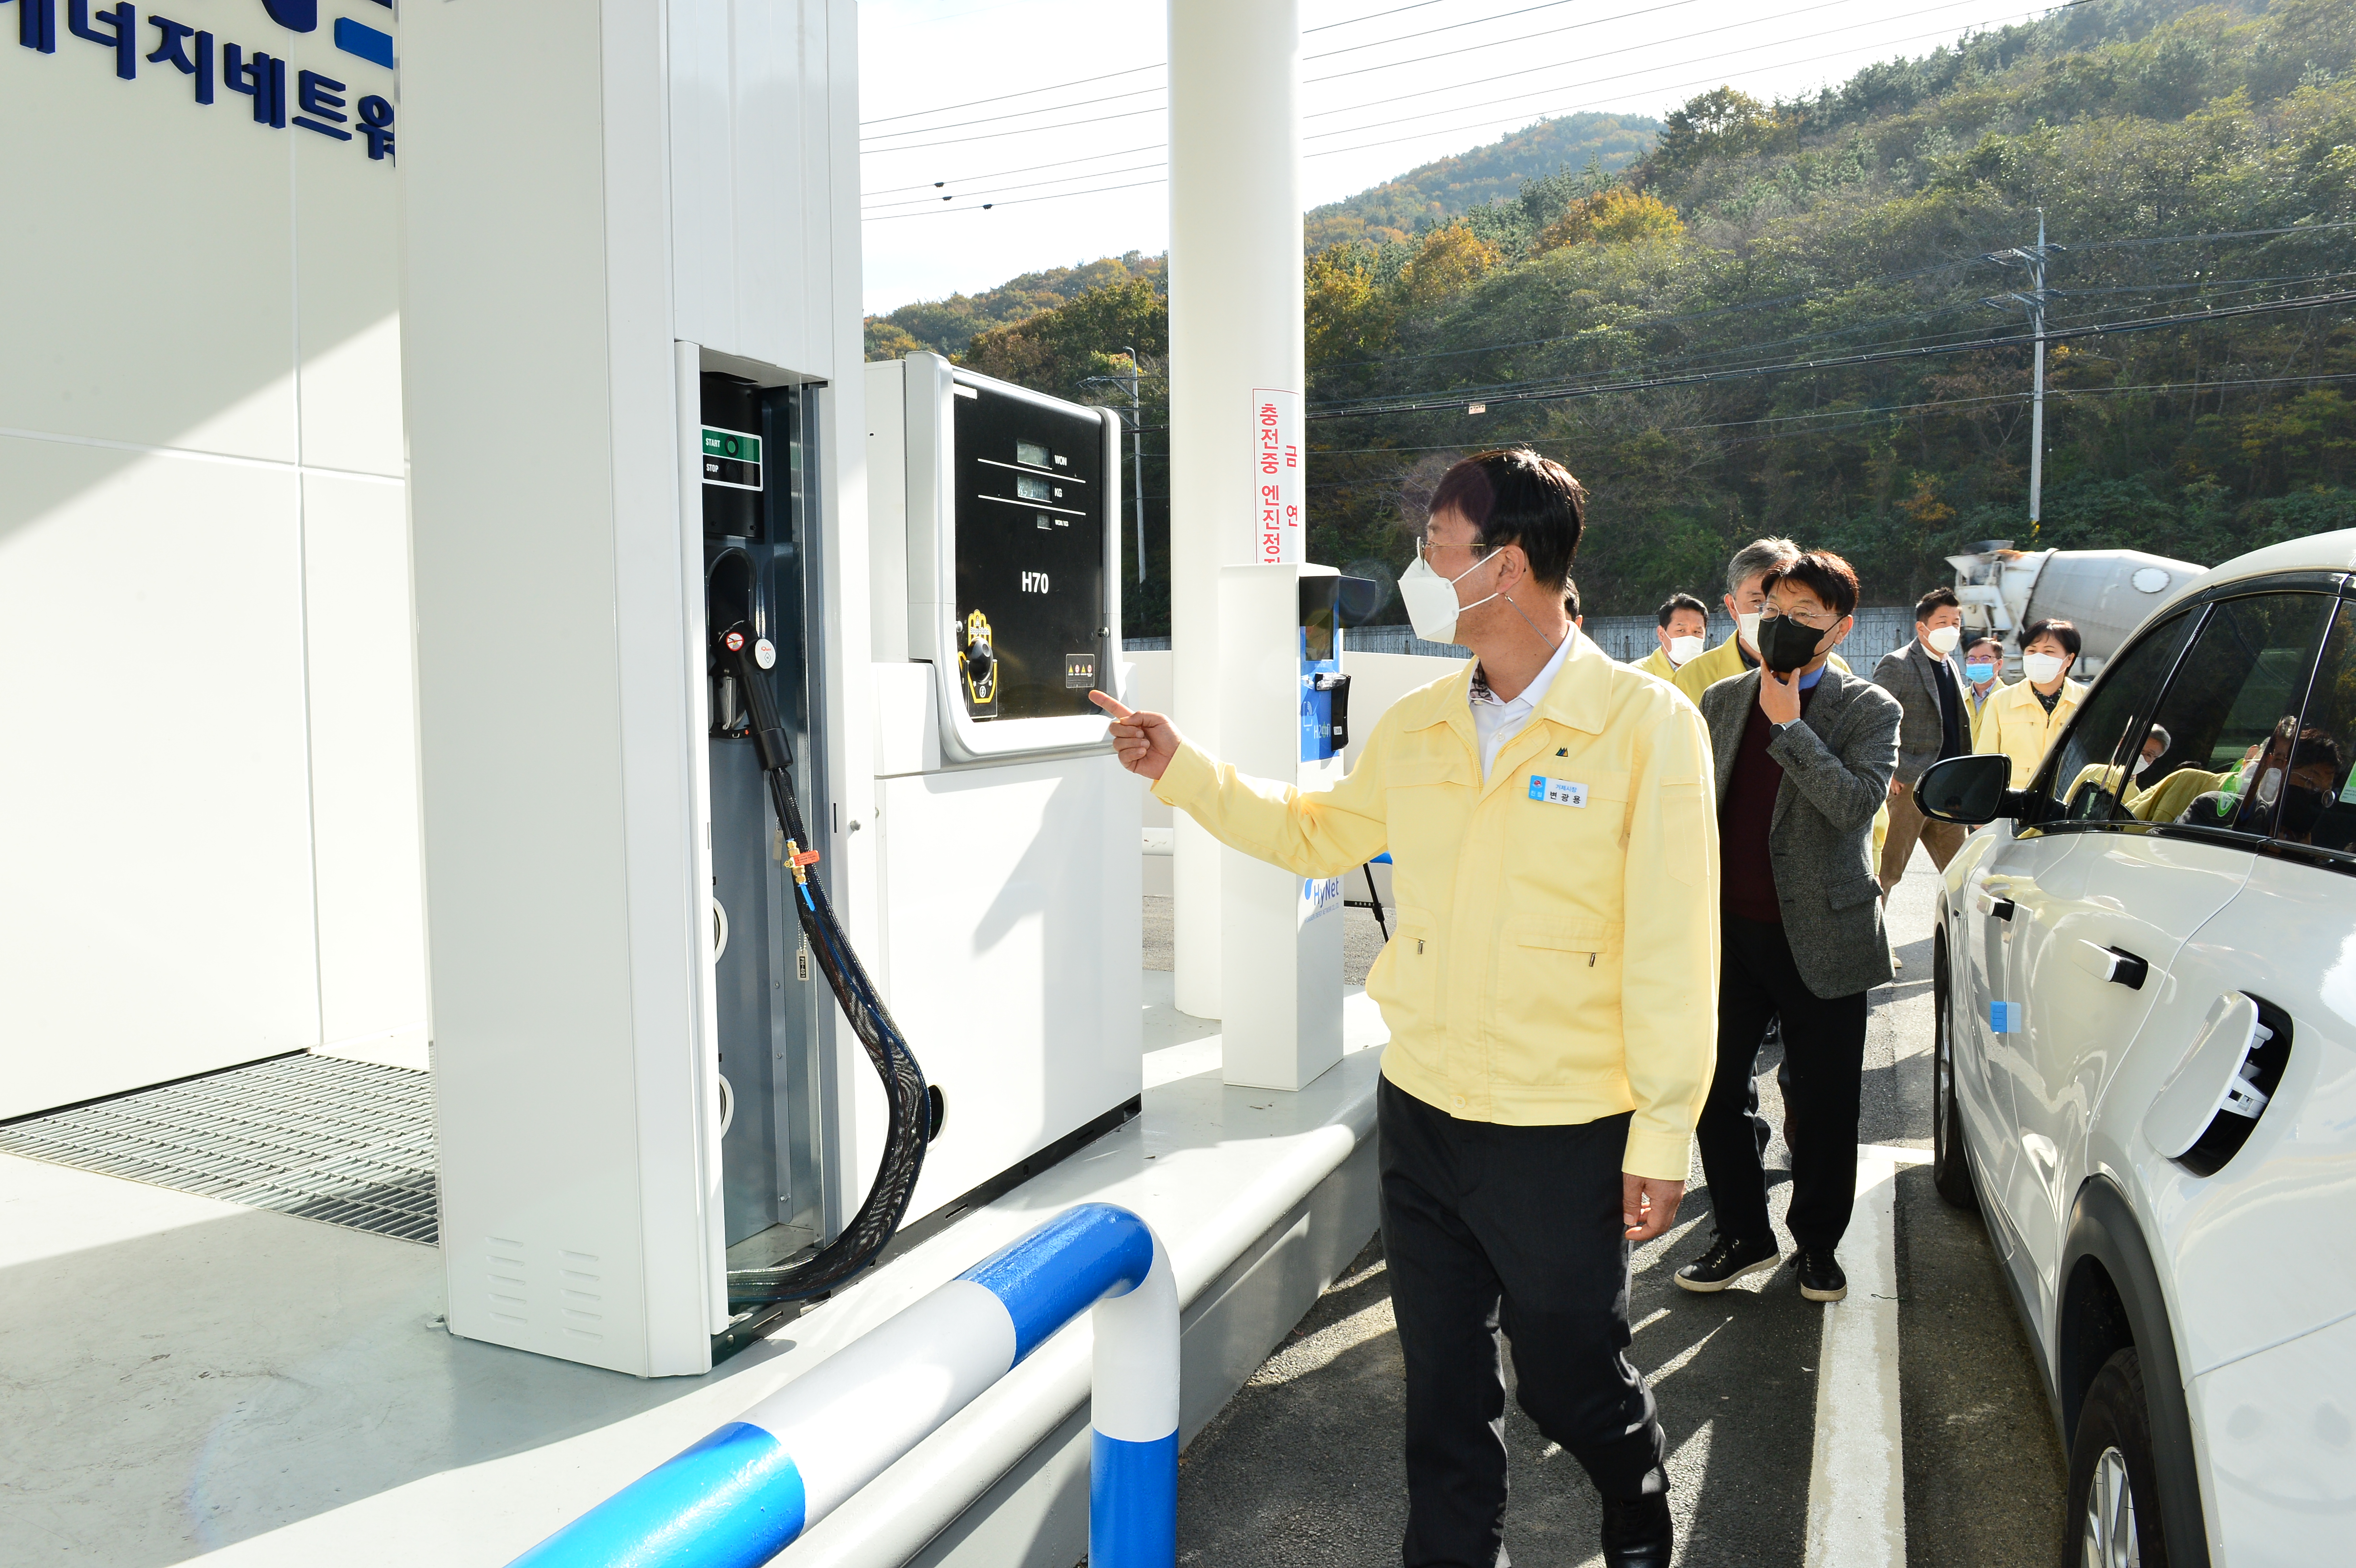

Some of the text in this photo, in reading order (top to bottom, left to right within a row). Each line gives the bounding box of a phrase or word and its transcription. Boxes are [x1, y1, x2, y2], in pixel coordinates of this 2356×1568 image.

[705, 437, 720, 448] START
[1054, 455, 1067, 466] WON
[706, 463, 719, 473] STOP
[1259, 403, 1280, 564] 충전중 엔진정
[1054, 488, 1062, 498] KG
[1022, 571, 1049, 594] H70
[1556, 784, 1577, 793] 거제시장
[1314, 877, 1339, 908] HyNet
